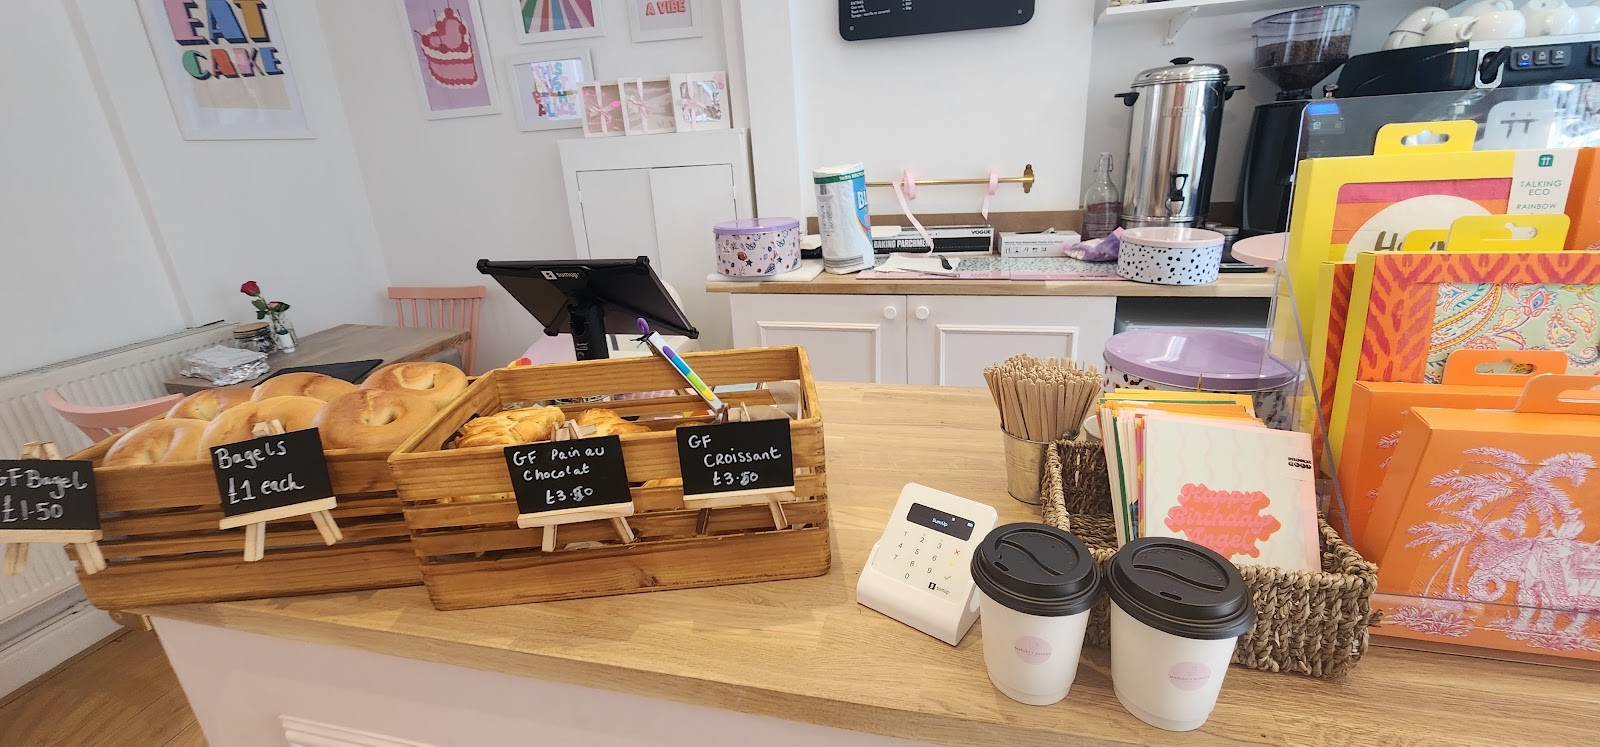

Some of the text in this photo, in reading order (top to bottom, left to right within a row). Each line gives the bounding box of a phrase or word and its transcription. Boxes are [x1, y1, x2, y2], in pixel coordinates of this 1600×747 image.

[646, 0, 686, 16] A VIBE
[163, 0, 271, 46] EAT
[182, 47, 284, 80] CAKE
[538, 103, 578, 117] PLACE
[1520, 180, 1562, 188] TALKING
[1528, 188, 1551, 196] ECO
[873, 238, 928, 249] BAKING PARCHME
[688, 434, 711, 449] GF
[214, 441, 287, 469] Bagels
[513, 446, 605, 466] GF Pain au
[523, 463, 591, 481] Chocolat
[24, 469, 88, 499] Bagel
[228, 473, 305, 504] £1 each
[1177, 483, 1266, 511] Happy
[1164, 505, 1275, 535] Birthday
[1184, 526, 1254, 553] Angel
